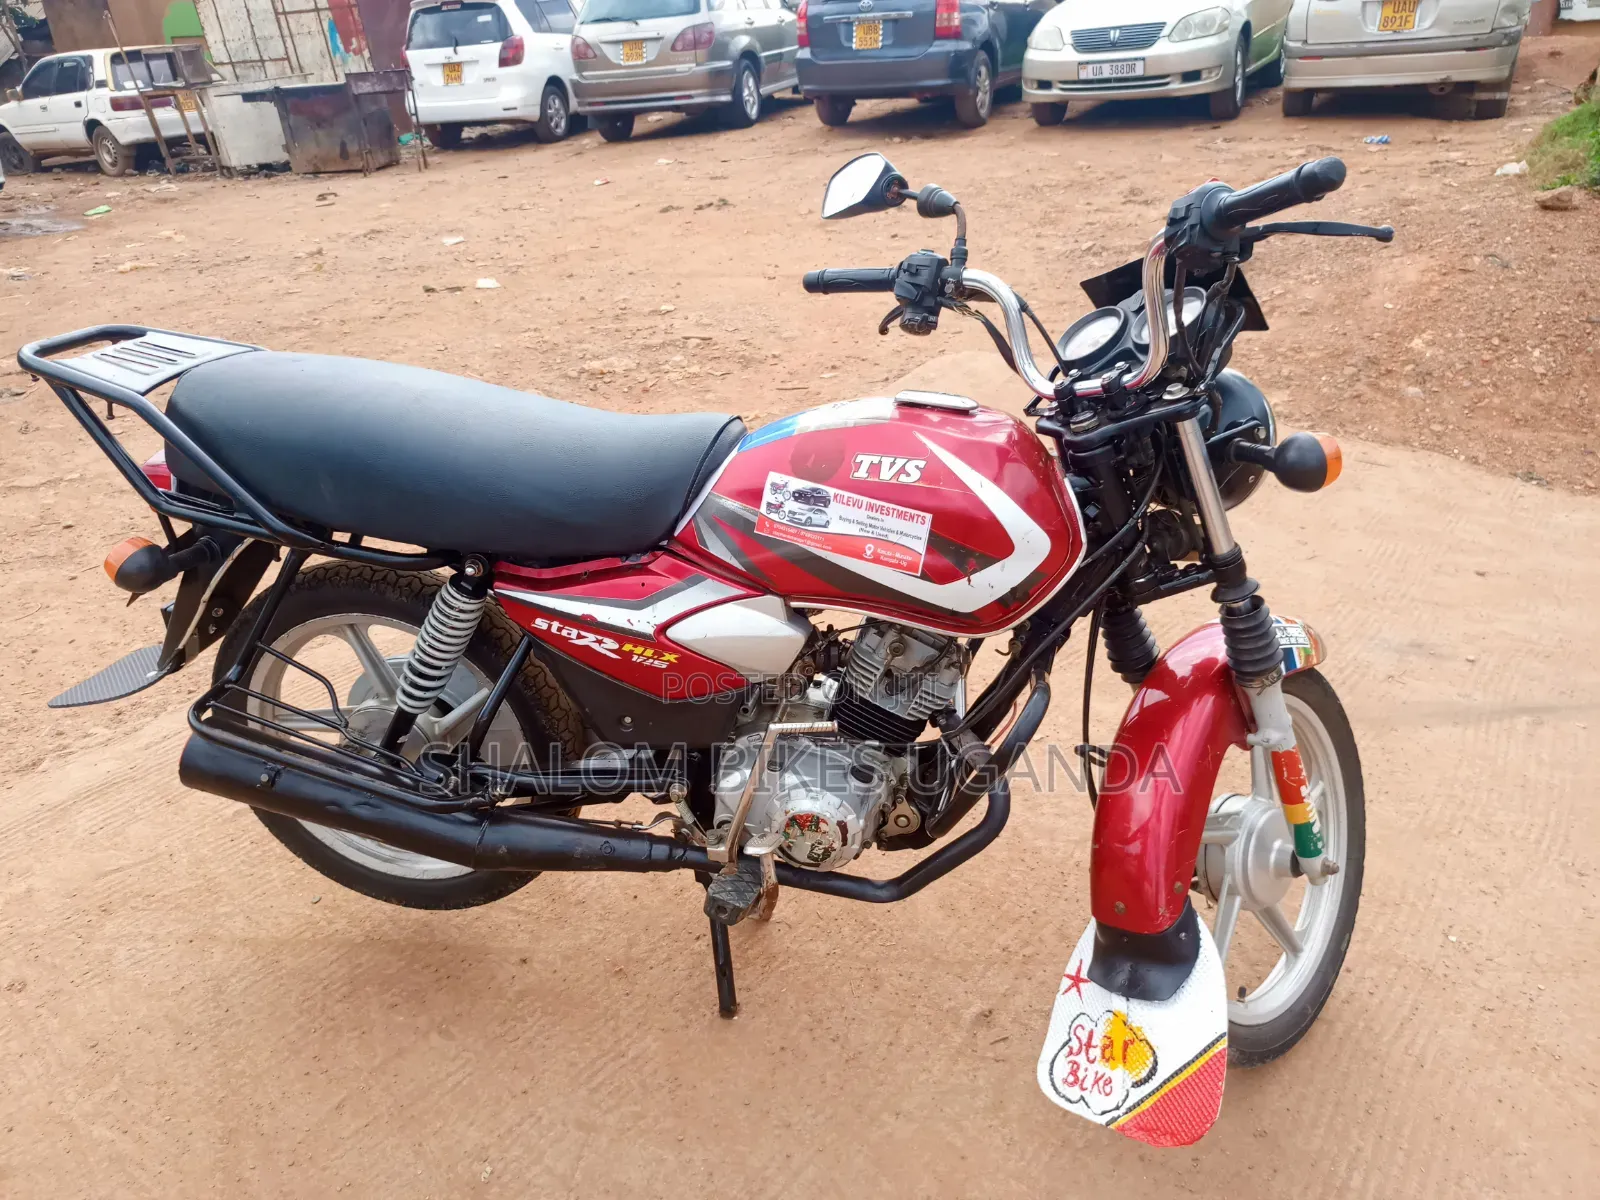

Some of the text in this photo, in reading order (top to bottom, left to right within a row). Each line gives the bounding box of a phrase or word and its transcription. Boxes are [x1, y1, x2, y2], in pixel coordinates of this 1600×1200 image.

[1382, 15, 1413, 29] 891F
[1092, 63, 1137, 77] UA 388DR
[852, 454, 927, 483] TVS
[833, 492, 927, 526] KILEVU INVESTMENTS
[838, 515, 852, 524] Buying
[856, 519, 868, 528] Selling
[868, 523, 880, 531] Motor
[880, 525, 896, 534] Vehicles
[621, 643, 681, 663] HLX
[1065, 1024, 1135, 1064] Star
